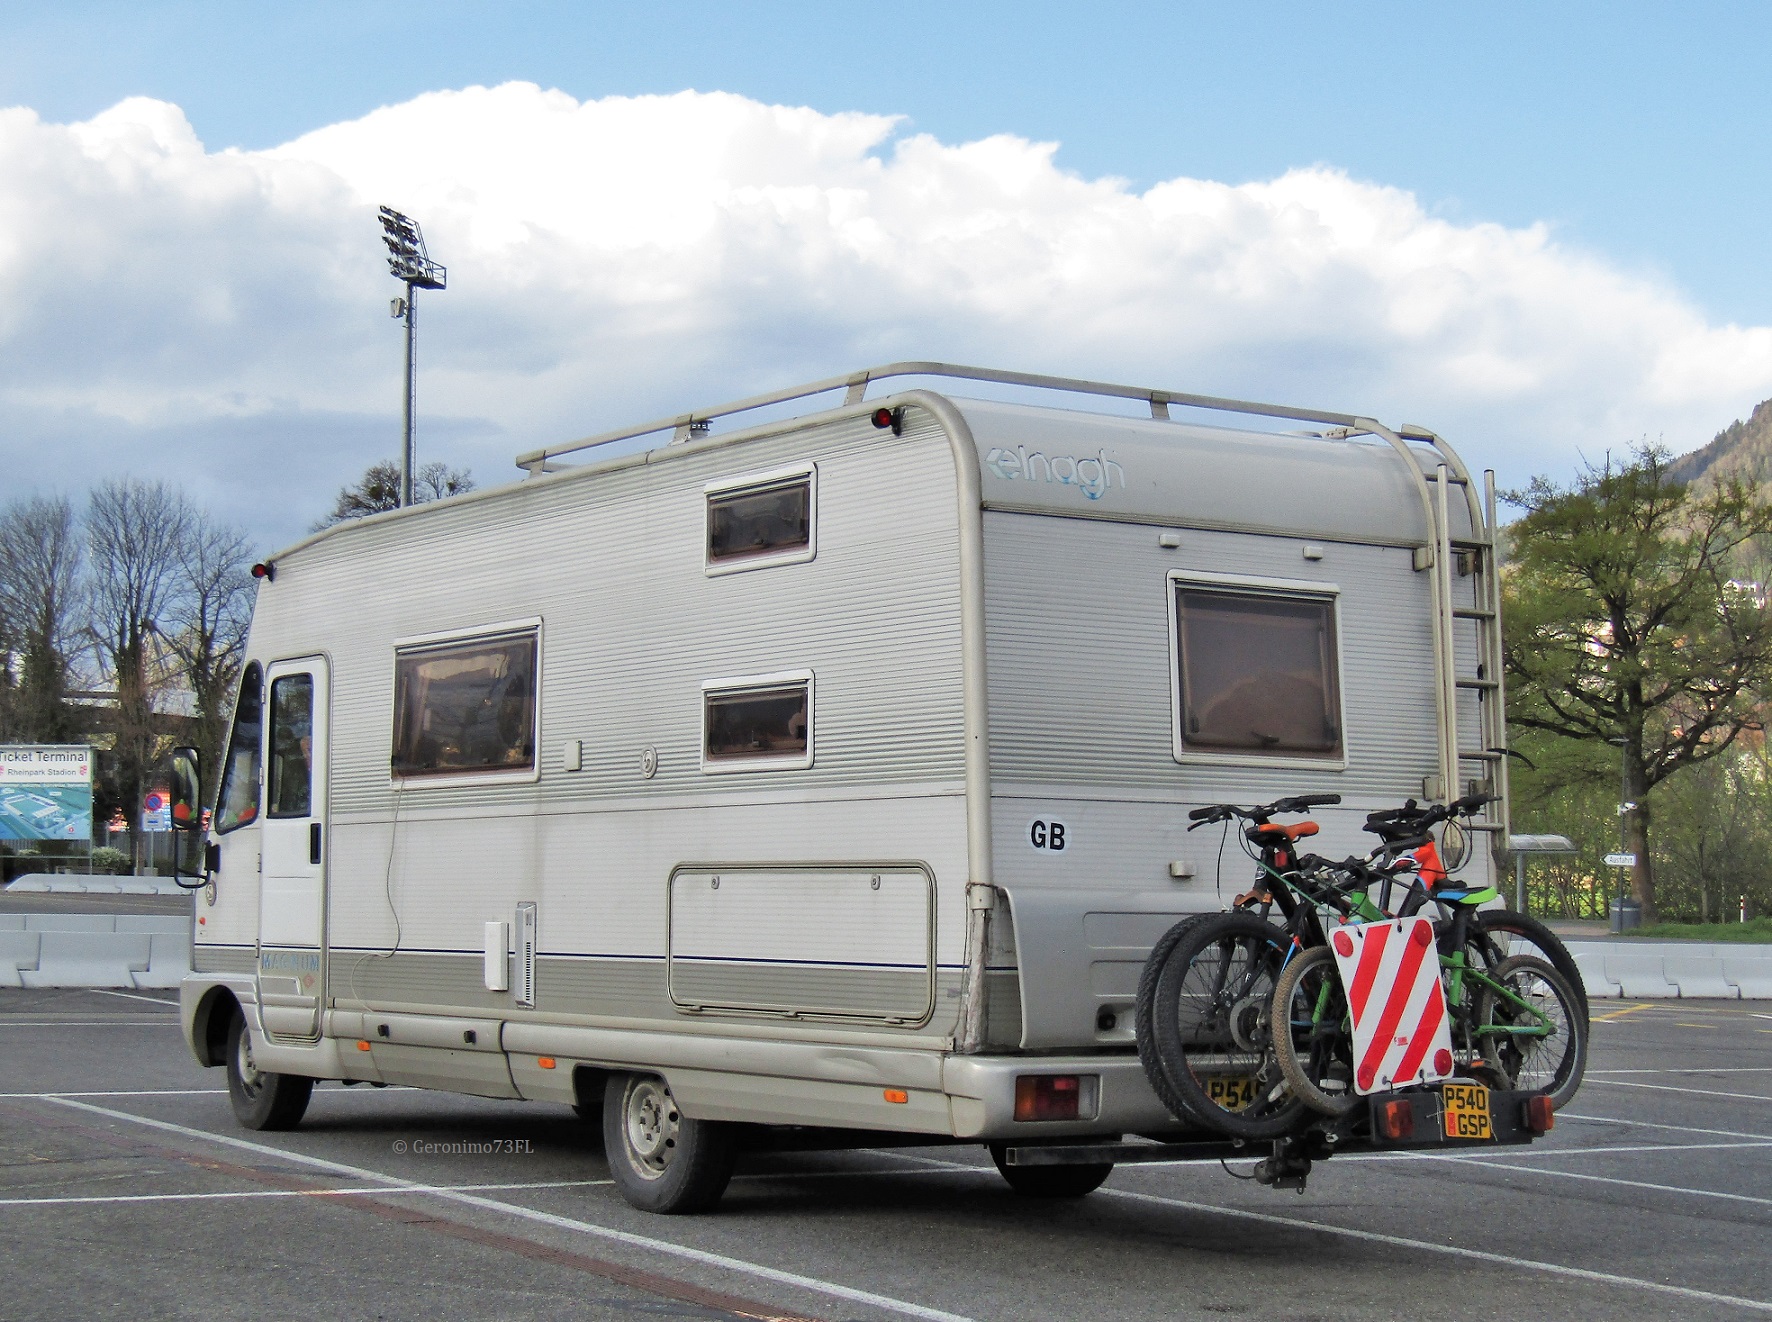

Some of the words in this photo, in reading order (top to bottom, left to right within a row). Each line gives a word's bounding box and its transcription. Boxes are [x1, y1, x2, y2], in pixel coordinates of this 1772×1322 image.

[985, 445, 1126, 500] elnagh
[36, 751, 88, 762] Terminal
[7, 768, 46, 776] Rheinpark
[47, 768, 77, 776] Stadion
[1031, 820, 1065, 850] GB
[1444, 1087, 1486, 1110] P540
[1458, 1113, 1488, 1136] GSP
